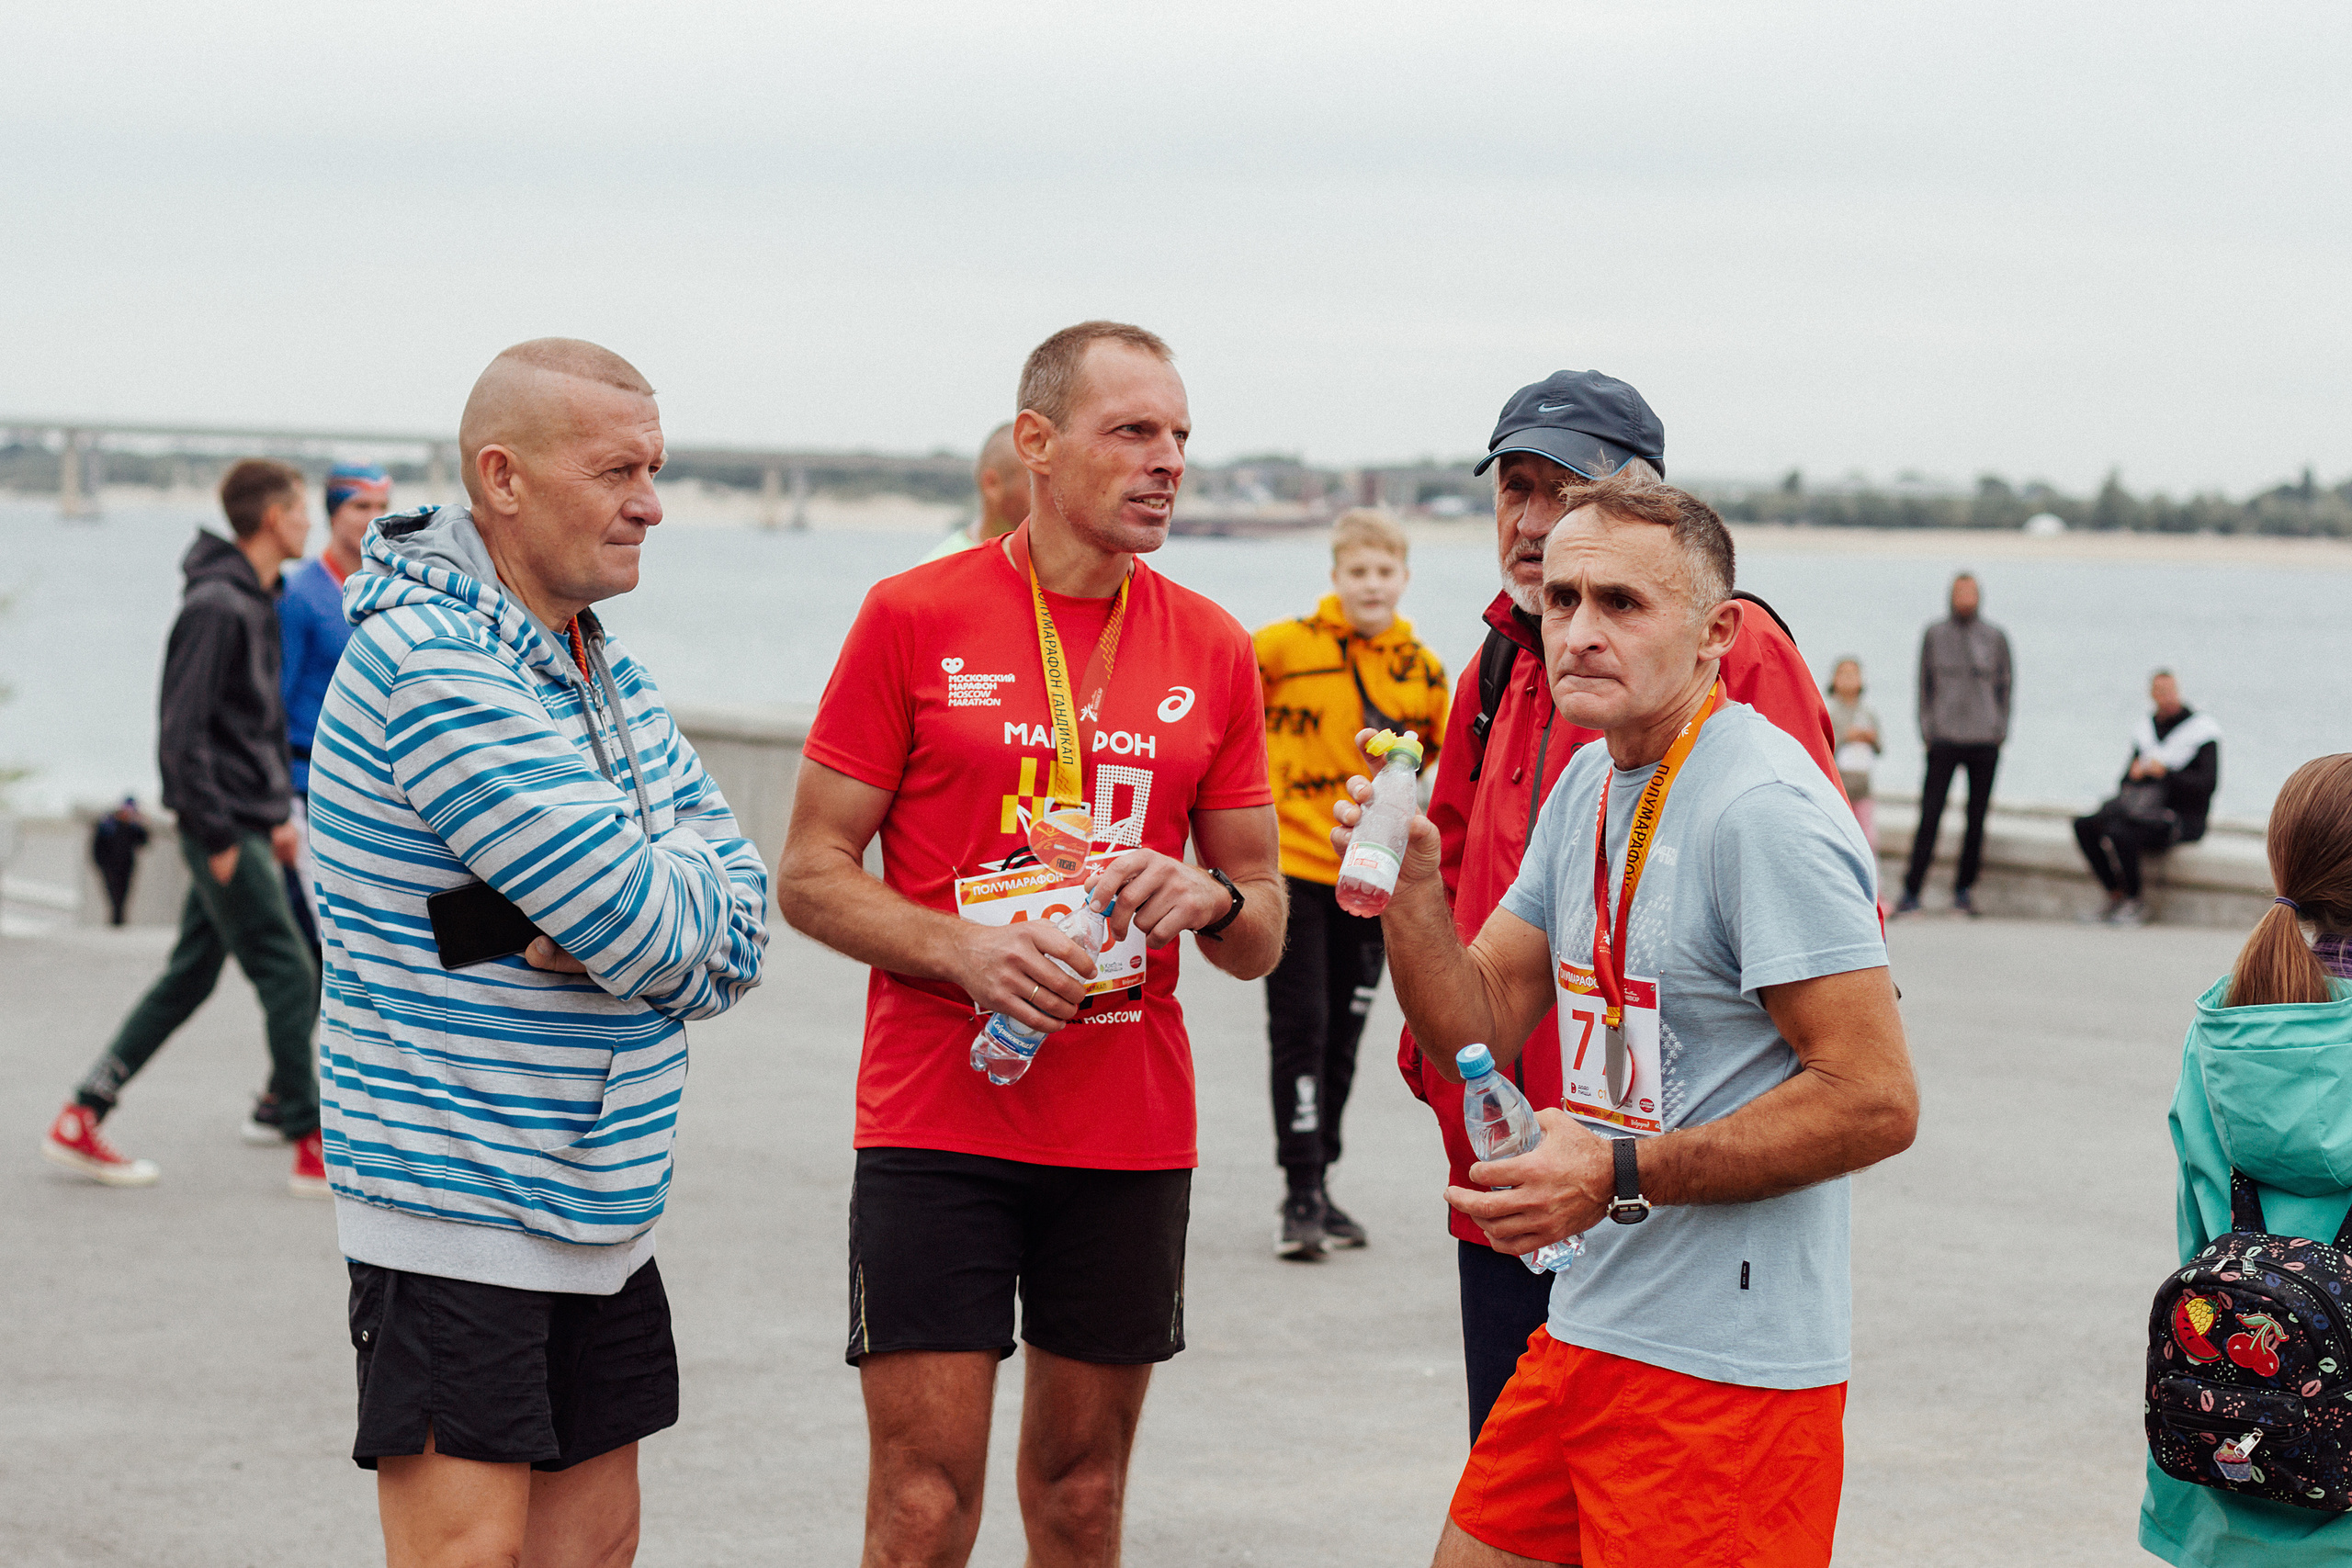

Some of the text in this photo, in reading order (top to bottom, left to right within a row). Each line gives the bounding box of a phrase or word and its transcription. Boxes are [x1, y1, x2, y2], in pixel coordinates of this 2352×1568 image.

[948, 673, 1015, 682] МОСКОВСКИЙ
[948, 682, 998, 691] МАРАФОН
[948, 690, 992, 698] MOSCOW
[948, 698, 1001, 706] MARATHON
[1052, 694, 1074, 765] ГАНДИКАП
[1624, 764, 1670, 886] ПОЛУМАРАФО
[972, 873, 1064, 896] ПОЛУМАРАФОН
[1084, 1010, 1142, 1025] MOSCOW
[1572, 1009, 1606, 1076] 7
